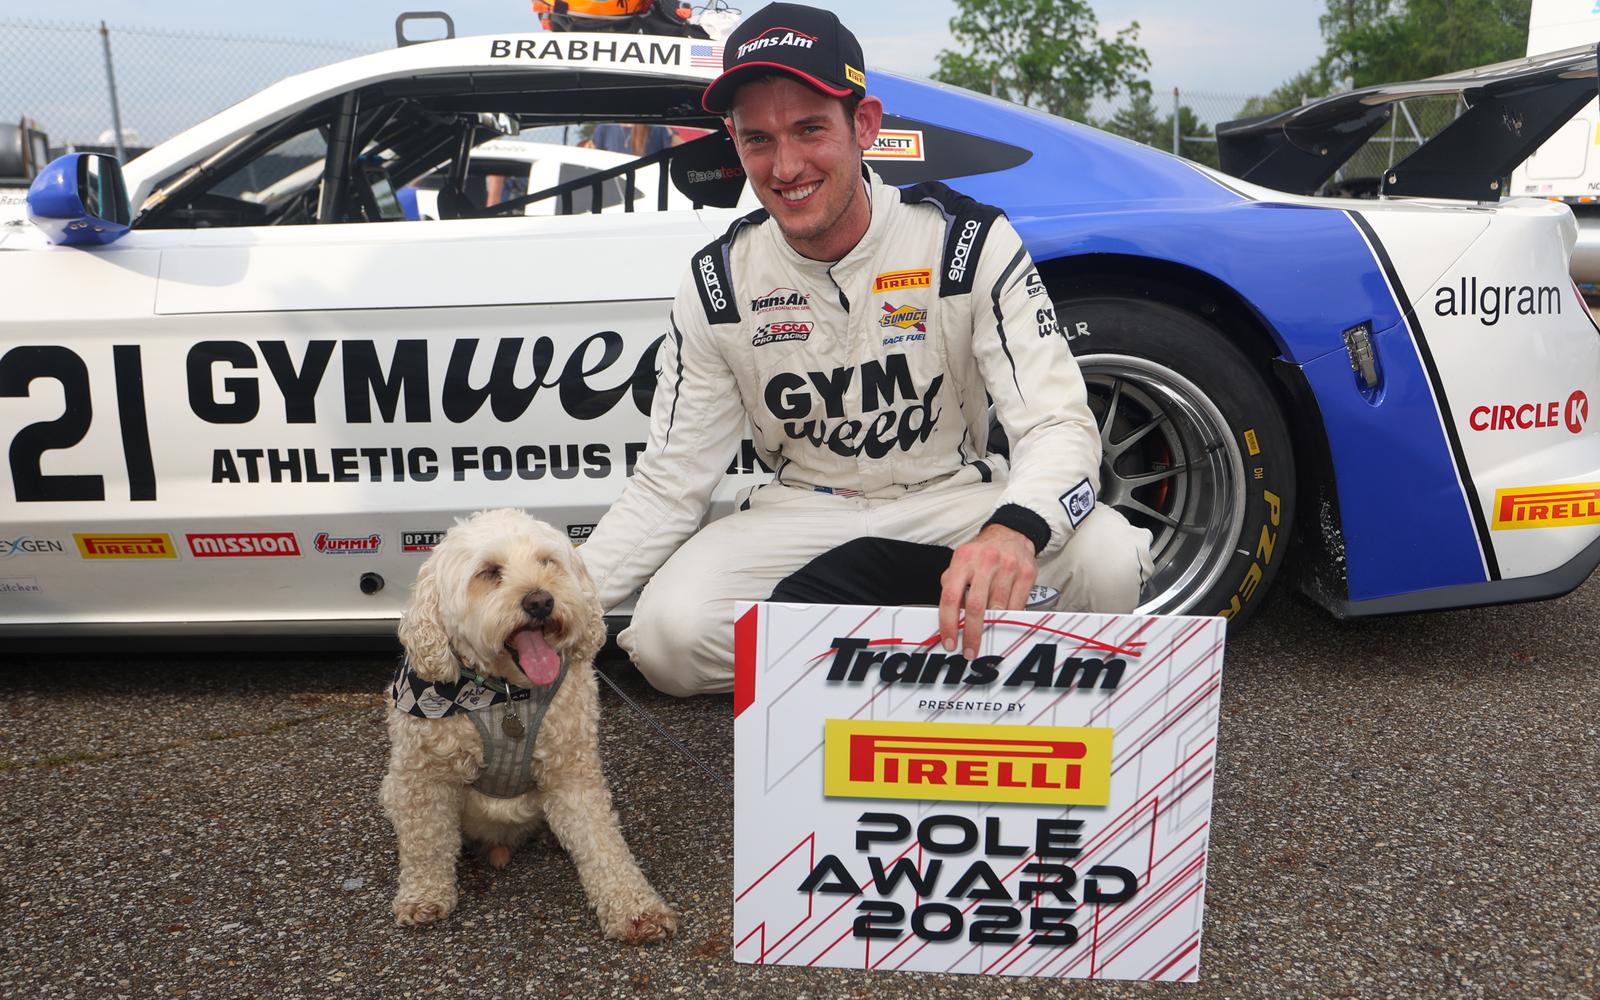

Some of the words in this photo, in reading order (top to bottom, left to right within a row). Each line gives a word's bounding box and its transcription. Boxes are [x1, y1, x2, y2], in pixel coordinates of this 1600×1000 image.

[490, 39, 681, 66] BRABHAM
[737, 35, 780, 59] Trans
[779, 32, 814, 48] Am
[687, 167, 742, 183] Racetec
[948, 220, 981, 283] sparco
[700, 254, 727, 312] sparco
[875, 271, 930, 290] PIRELLI
[1435, 276, 1561, 326] allgram
[770, 323, 810, 333] SCCA
[883, 311, 928, 325] SUNOCO
[1063, 322, 1091, 341] LR
[753, 335, 773, 346] PRO
[775, 333, 808, 341] RACING
[882, 335, 905, 347] RACE
[906, 333, 926, 342] FUEL
[764, 354, 919, 419] GYM
[0, 345, 156, 502] 21
[783, 373, 945, 459] weed
[1469, 402, 1559, 432] CIRCLE
[212, 446, 438, 483] ATHLETIC
[452, 443, 611, 482] FOCUS
[1253, 467, 1264, 480] DH
[83, 537, 167, 555] PIRELLI
[825, 637, 1004, 687] Trans
[1002, 643, 1127, 690] Am
[918, 700, 1003, 712] PRESENTED
[1007, 702, 1026, 712] BY
[849, 734, 1088, 790] PIRELLI
[855, 811, 1086, 859] POLE
[797, 854, 1139, 905] AWARD
[852, 900, 1079, 947] 2025
